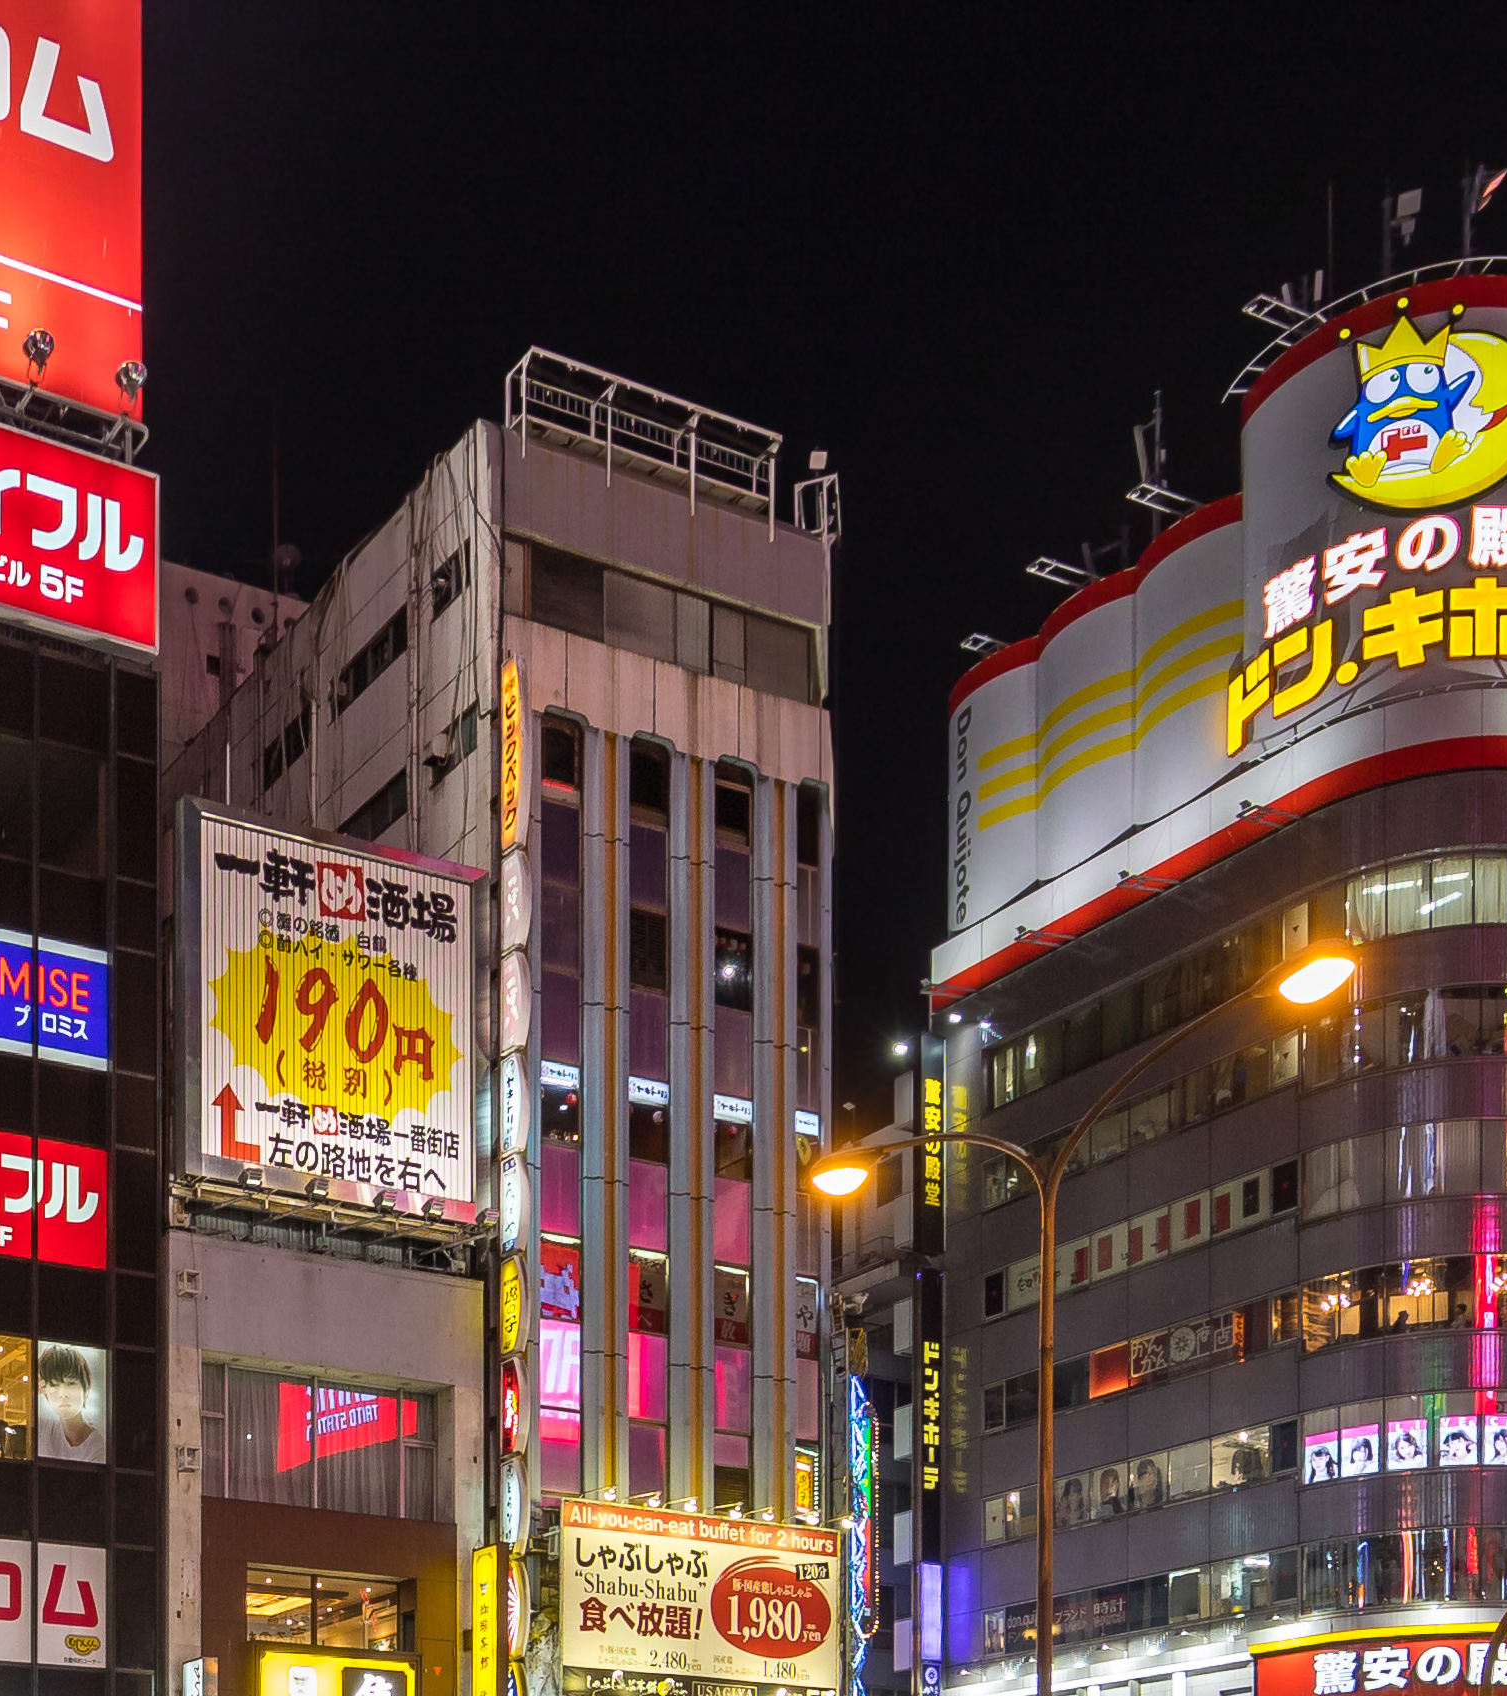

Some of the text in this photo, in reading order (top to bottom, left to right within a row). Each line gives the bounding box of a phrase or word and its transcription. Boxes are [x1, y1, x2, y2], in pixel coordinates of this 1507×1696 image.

[39, 564, 85, 604] 5F
[214, 848, 458, 943] 一軒め酒場
[255, 954, 435, 1082] 190円
[276, 1049, 392, 1107] (税別)
[255, 1097, 460, 1161] 一軒め酒場一番街店
[268, 1133, 446, 1192] 左の路地を右へ
[569, 1509, 834, 1553] All-you-can-eat buffet for 2 hours
[575, 1537, 709, 1578] しゃぶしゃぶ
[578, 1597, 703, 1641] 食べ放題!
[727, 1594, 804, 1643] 1,980
[649, 1650, 687, 1670] 2,480
[762, 1661, 797, 1680] 1,480
